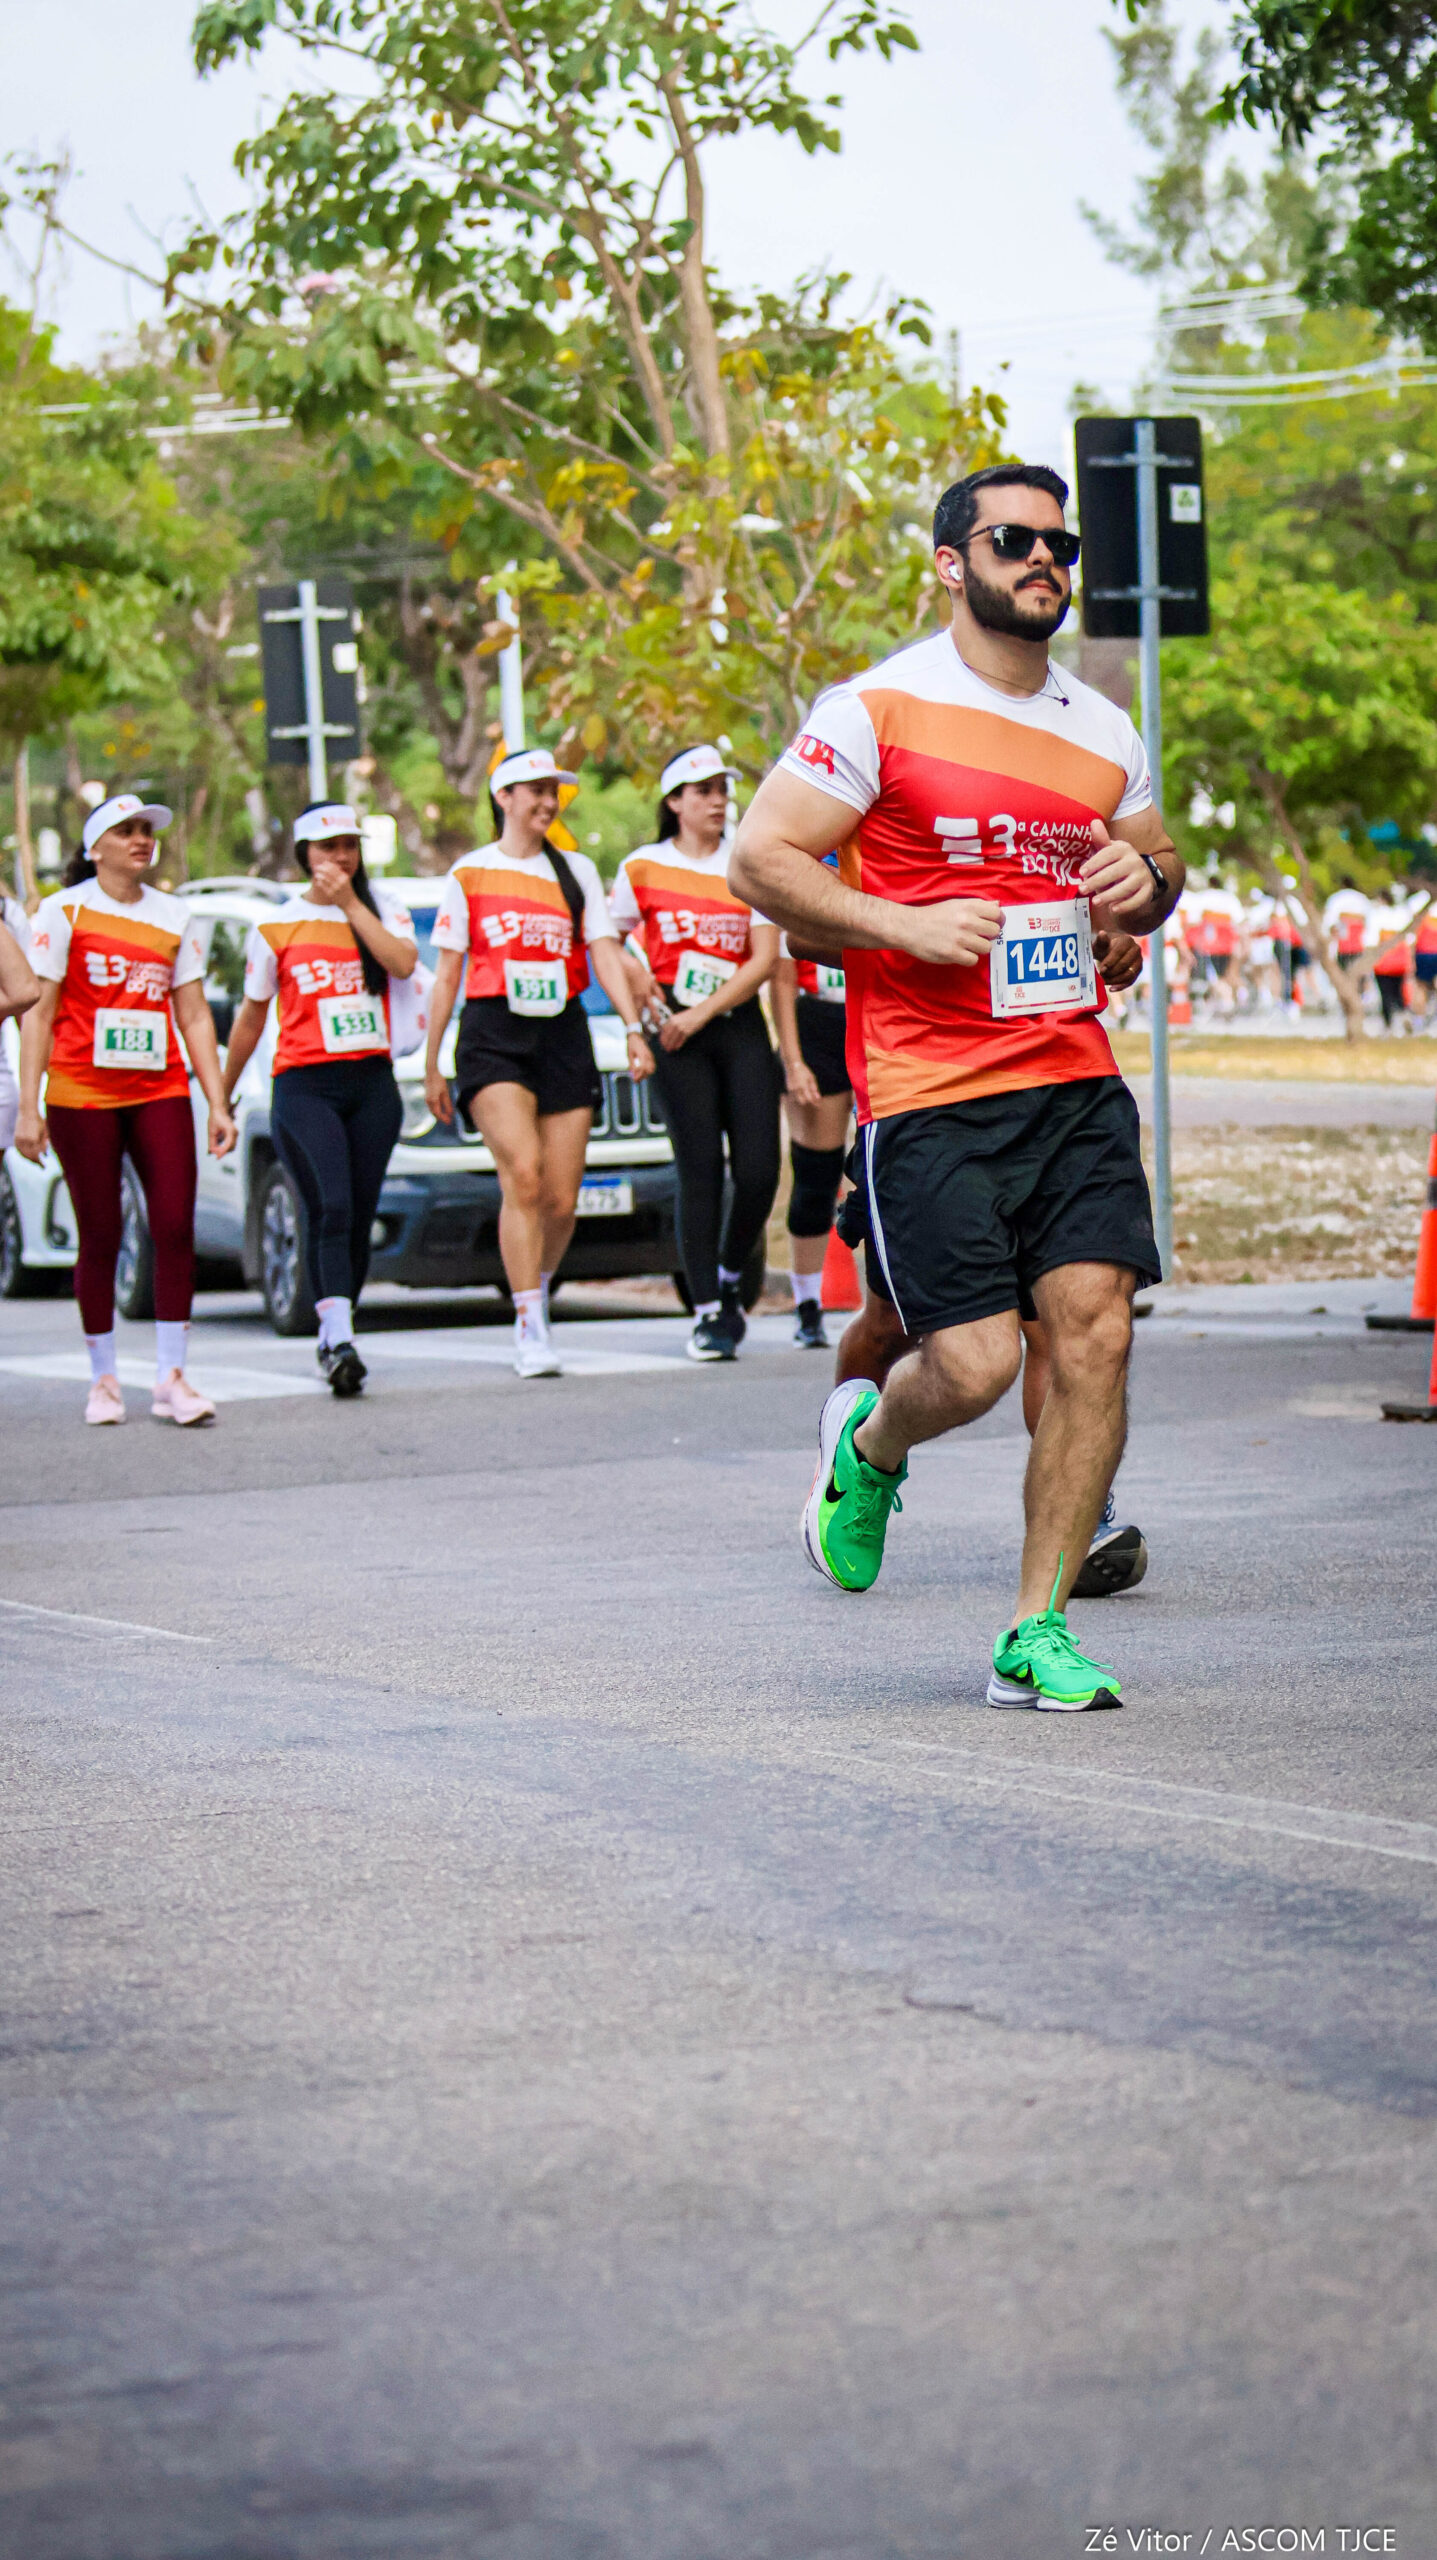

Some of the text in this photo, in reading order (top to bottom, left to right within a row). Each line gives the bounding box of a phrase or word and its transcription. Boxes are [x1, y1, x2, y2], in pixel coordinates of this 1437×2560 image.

[1029, 820, 1093, 841] CAMINH
[1049, 855, 1084, 887] TJC
[1009, 936, 1078, 981] 1448
[519, 979, 551, 1001] 391
[338, 1012, 373, 1035] 533
[112, 1030, 150, 1051] 188
